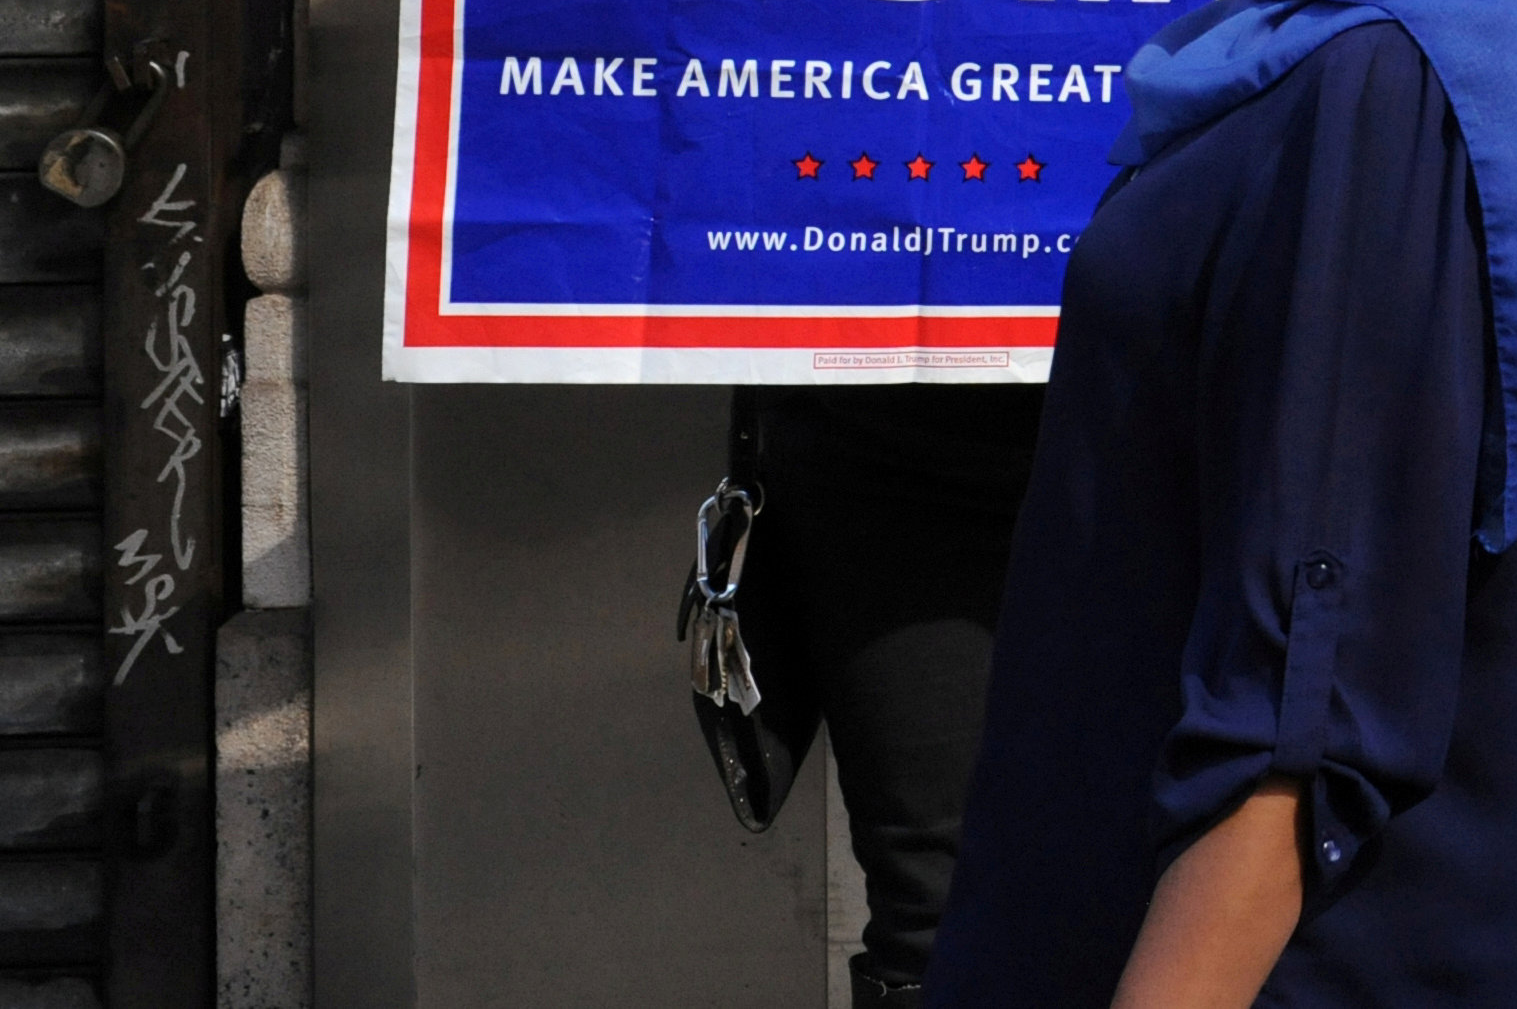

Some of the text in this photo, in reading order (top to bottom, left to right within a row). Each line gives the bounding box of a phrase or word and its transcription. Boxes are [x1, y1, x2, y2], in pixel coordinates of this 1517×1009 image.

[499, 56, 1123, 103] MAKE AMERICA GREAT
[706, 225, 1080, 259] www.DonaldJTrump.c
[817, 356, 837, 365] Paid
[839, 355, 851, 365] for
[853, 356, 863, 367] by
[865, 356, 895, 365] Donald
[905, 354, 930, 365] Trump
[931, 354, 944, 365] for
[945, 354, 988, 366] President,
[990, 354, 1006, 364] Inc.
